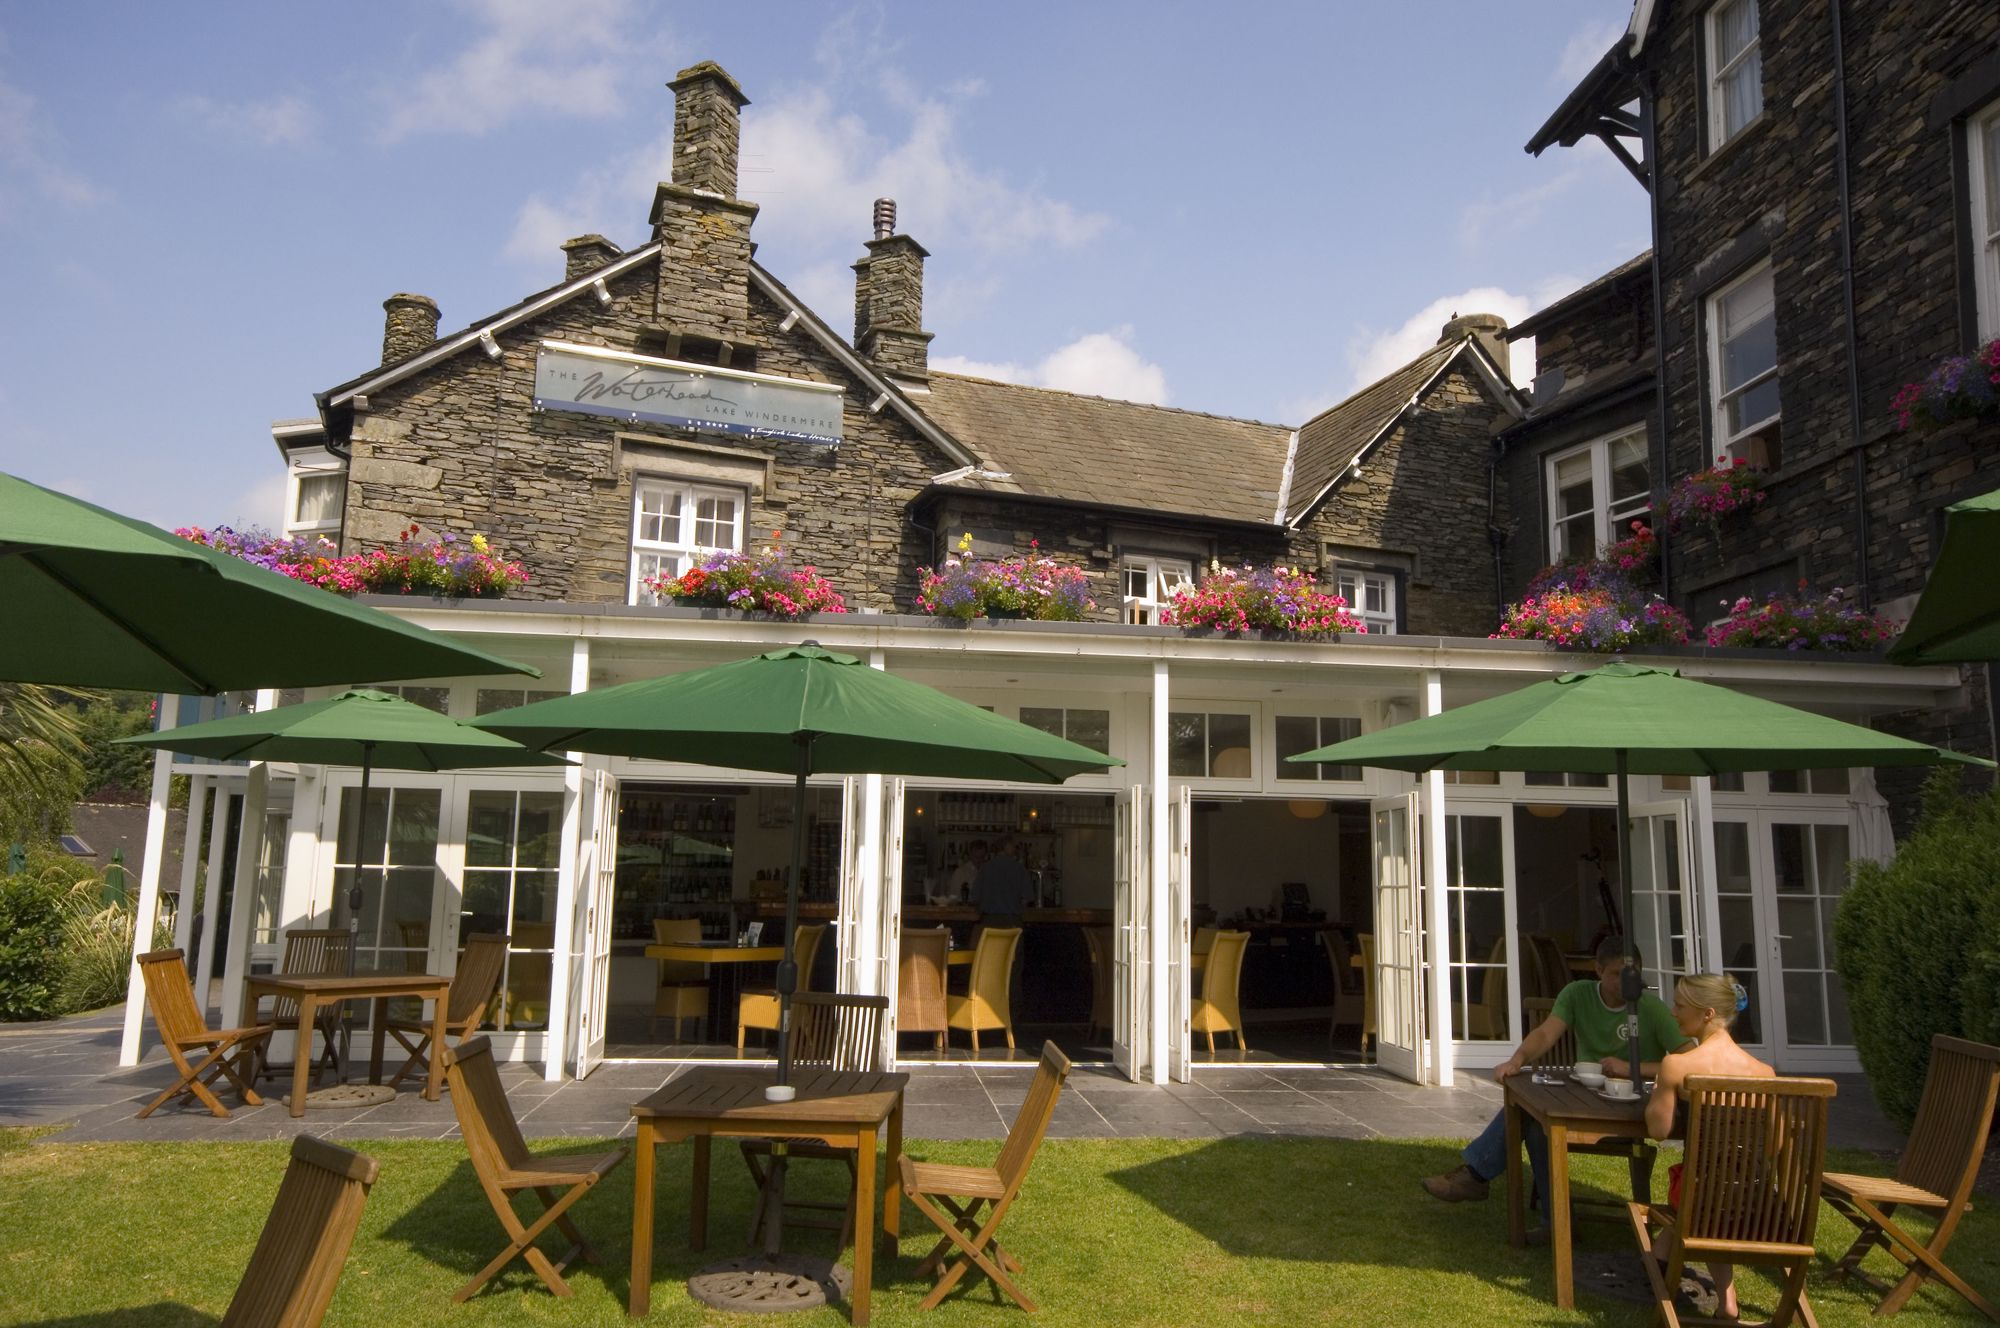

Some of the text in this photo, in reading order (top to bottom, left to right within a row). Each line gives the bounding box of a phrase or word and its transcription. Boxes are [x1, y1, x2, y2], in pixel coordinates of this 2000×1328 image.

[549, 368, 738, 406] THE Waterhead
[705, 404, 833, 429] LAKE WINDERMERE
